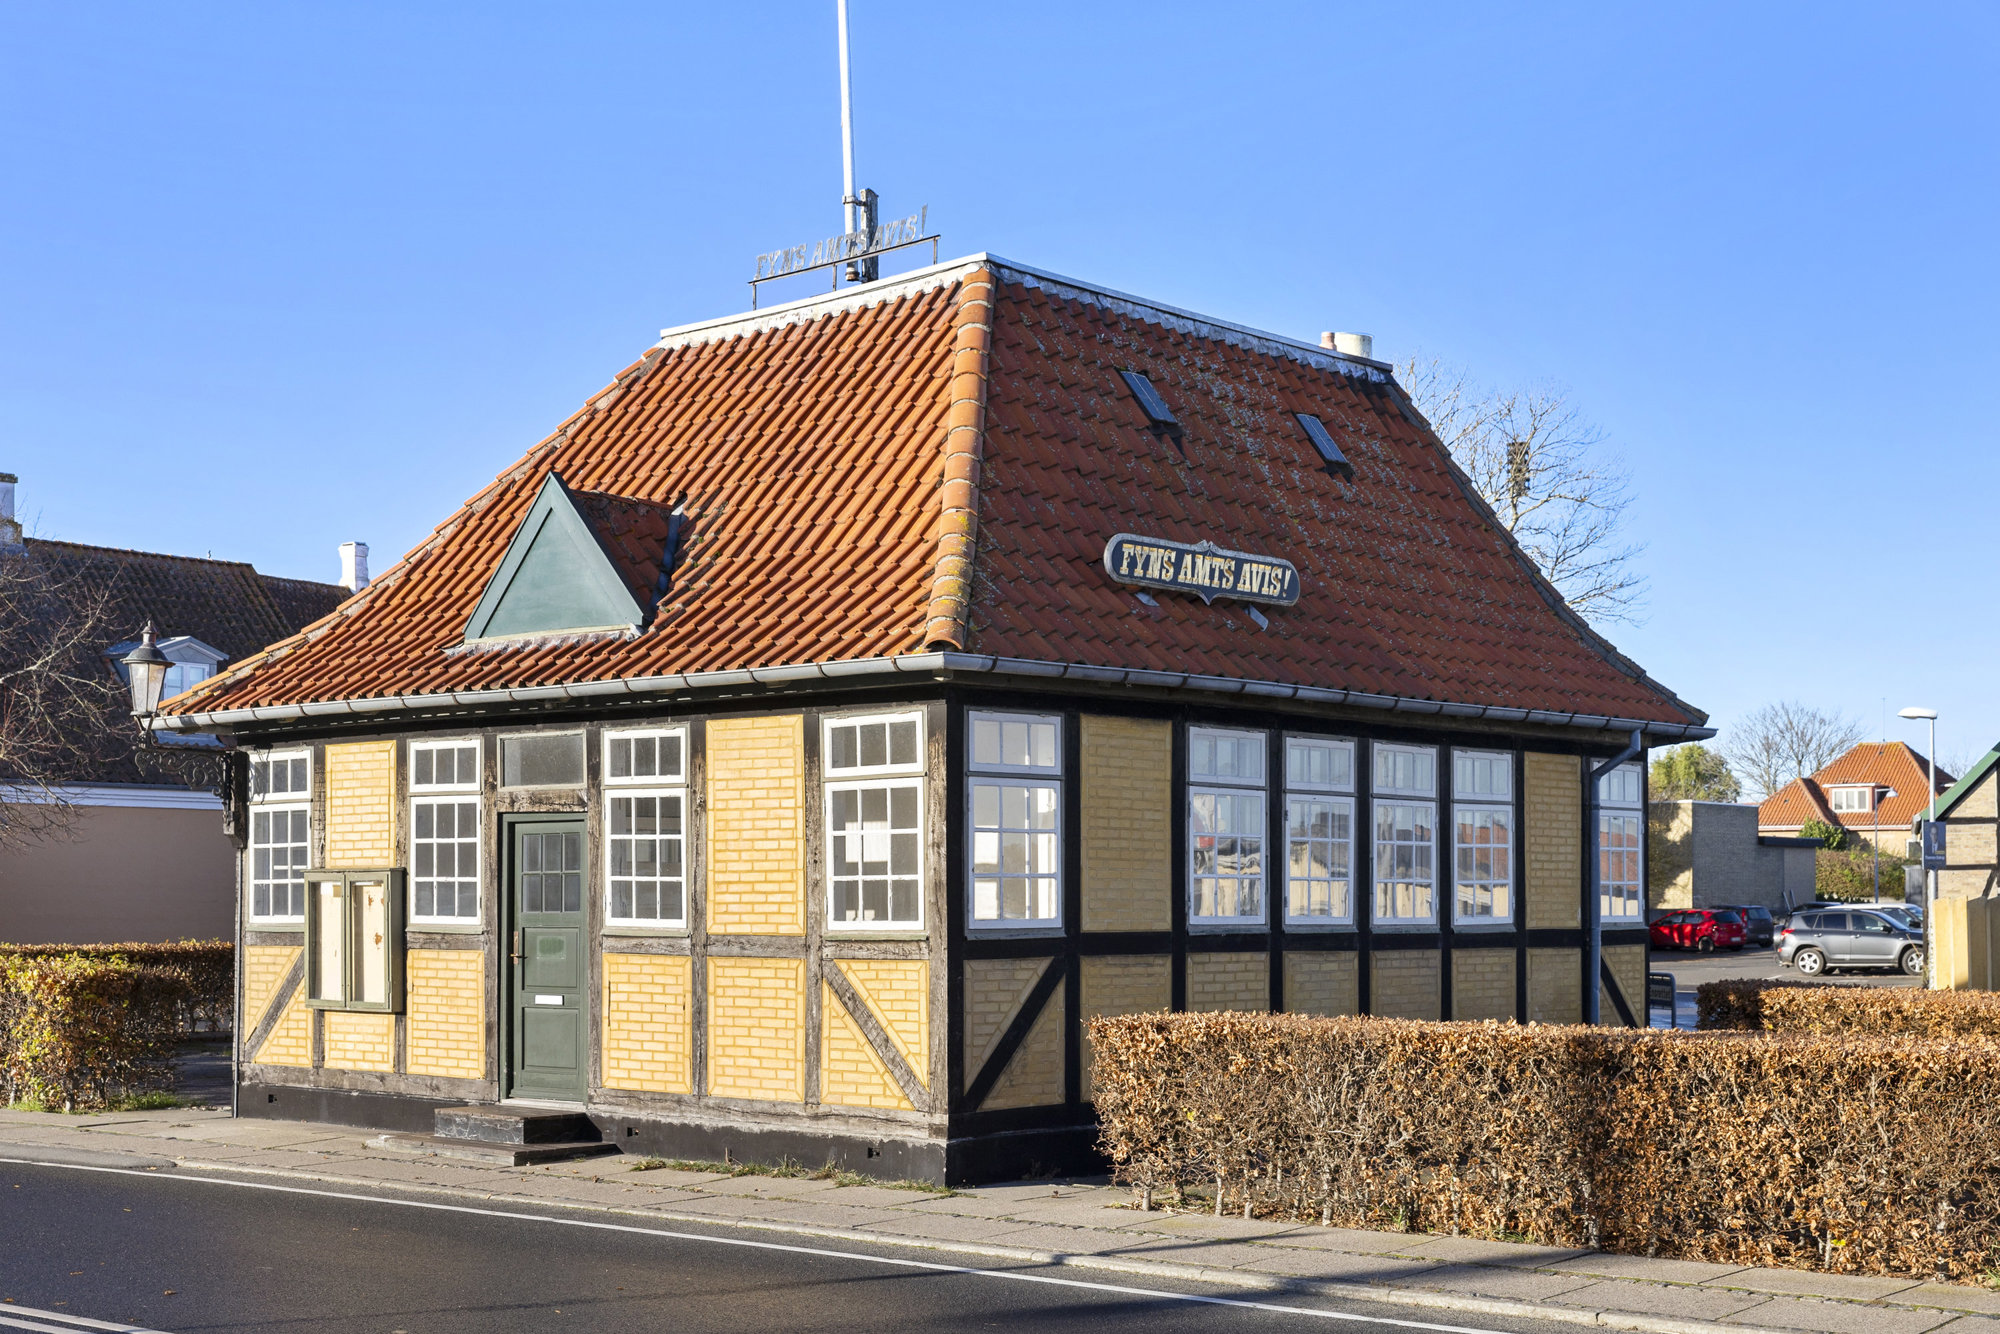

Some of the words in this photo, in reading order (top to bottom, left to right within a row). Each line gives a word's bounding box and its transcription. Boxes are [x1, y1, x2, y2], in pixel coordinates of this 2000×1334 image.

[753, 243, 807, 280] FYNS
[809, 228, 869, 267] AMTS
[869, 203, 929, 252] AVIS!
[1119, 543, 1176, 582] FYNS
[1177, 553, 1236, 589] AMTS
[1237, 562, 1292, 597] AVIS!
